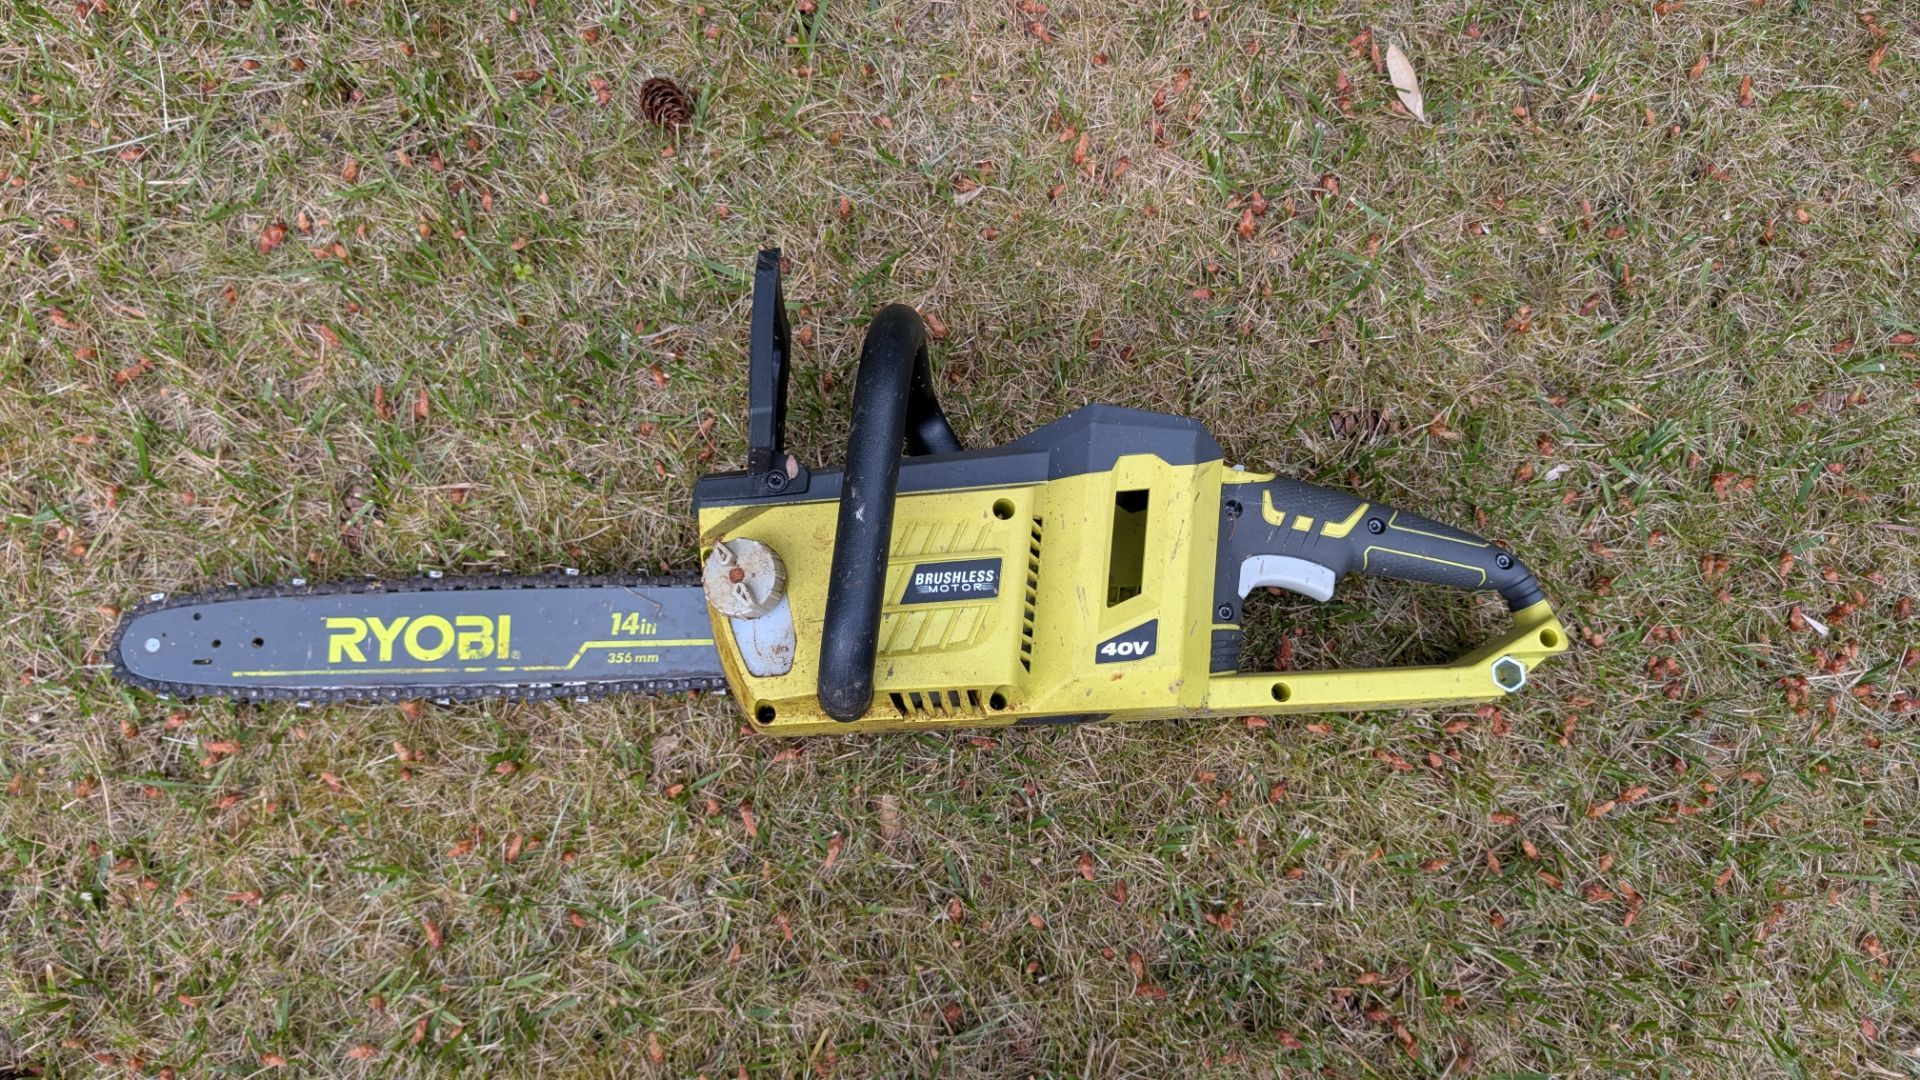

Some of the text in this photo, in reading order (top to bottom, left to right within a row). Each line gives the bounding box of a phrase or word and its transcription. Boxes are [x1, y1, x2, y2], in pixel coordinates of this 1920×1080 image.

[915, 570, 995, 586] BRUSHLESS
[928, 583, 982, 593] MOTOR
[1100, 641, 1150, 656] 40V
[607, 652, 659, 664] 356 mm
